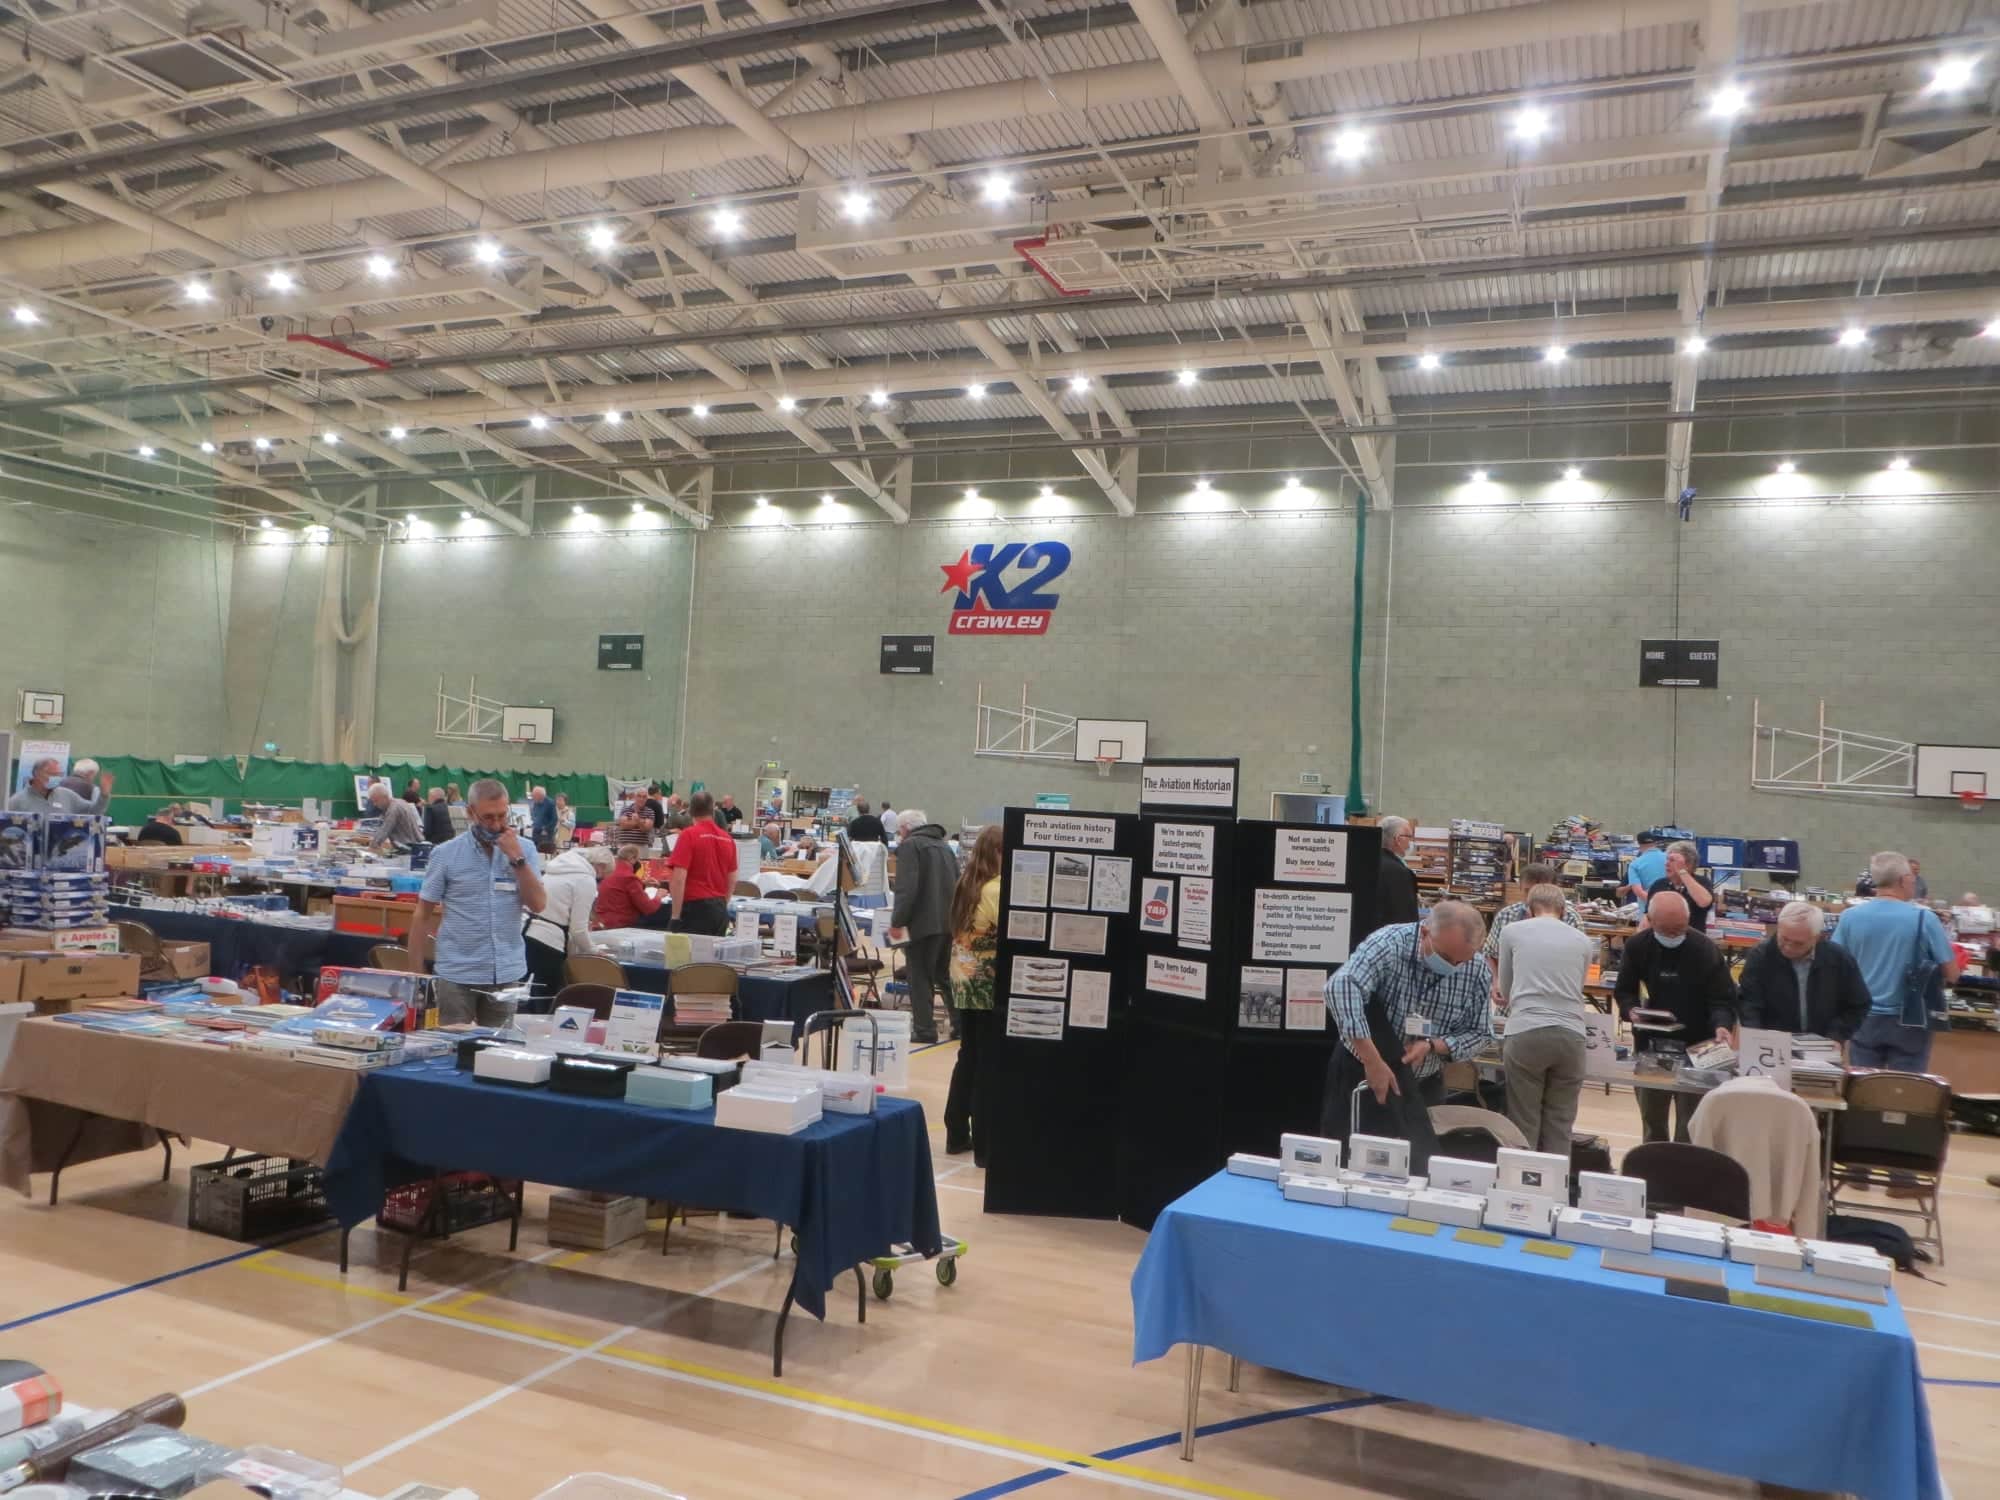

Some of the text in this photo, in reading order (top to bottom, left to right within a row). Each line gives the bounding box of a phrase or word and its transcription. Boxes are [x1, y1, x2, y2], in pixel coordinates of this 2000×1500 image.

[952, 541, 1071, 609] K2
[1689, 652, 1717, 661] GUESTS
[1144, 777, 1231, 791] The Aviation Historian
[1026, 819, 1048, 829] Fresh
[1050, 822, 1081, 830] aviation
[1033, 832, 1052, 841] Four
[1054, 833, 1075, 842] times
[1085, 835, 1104, 845] year.
[1185, 829, 1204, 838] world's
[1288, 835, 1300, 843] Not
[1291, 845, 1330, 853] newsagents
[1169, 861, 1174, 869] &
[1186, 863, 1195, 871] out
[1285, 857, 1336, 868] Buy here today
[1262, 892, 1289, 901] In-depth
[1262, 903, 1292, 912] Exploring
[1294, 904, 1304, 912] the
[1266, 912, 1284, 920] paths
[1294, 912, 1312, 921] flying
[1313, 913, 1336, 922] history
[70, 931, 108, 943] Apples
[1265, 929, 1292, 938] material
[1289, 942, 1307, 950] maps
[1154, 960, 1198, 976] Buy here today
